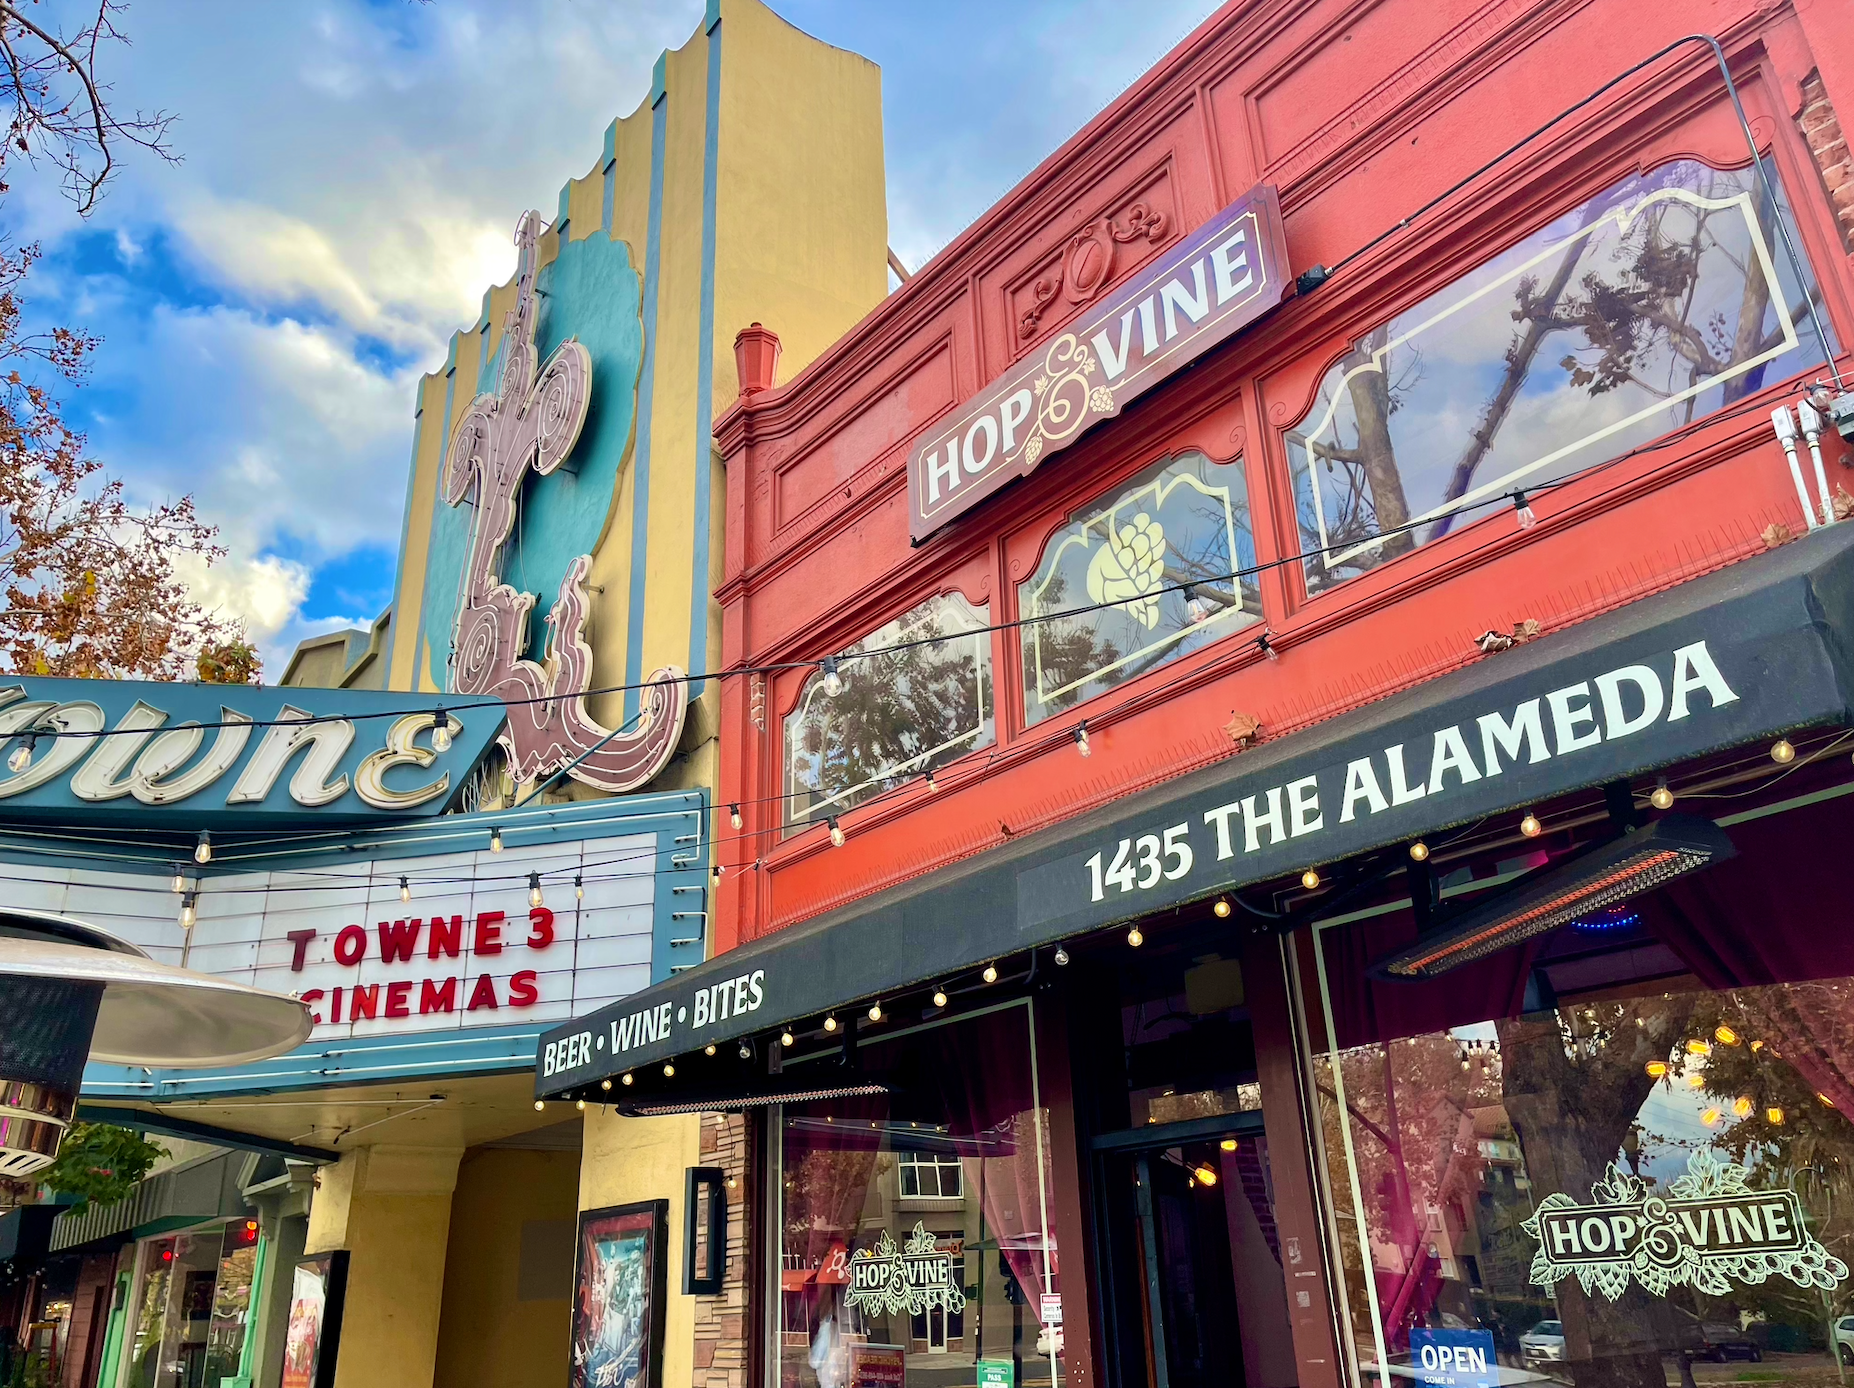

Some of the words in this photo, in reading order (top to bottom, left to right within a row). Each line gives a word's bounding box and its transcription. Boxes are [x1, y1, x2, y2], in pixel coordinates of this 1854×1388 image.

[926, 388, 1033, 506] HOP
[1091, 229, 1255, 381] VINE
[0, 684, 464, 810] owne
[1084, 822, 1194, 902] 1435
[1203, 775, 1325, 862] THE
[1338, 640, 1740, 824] ALAMEDA
[527, 907, 555, 950] 3
[299, 969, 539, 1024] CINEMAS
[543, 1030, 592, 1078] BEER
[610, 1001, 672, 1055] WINE
[692, 969, 765, 1030] BITES
[1550, 1214, 1637, 1255] HOP
[1677, 1202, 1793, 1247] VINE
[855, 1263, 890, 1288] HOP
[906, 1259, 948, 1285] VINE
[987, 1373, 1002, 1382] PASS
[1421, 1344, 1487, 1374] OPEN
[1424, 1375, 1445, 1384] COME
[1447, 1377, 1456, 1385] IN
